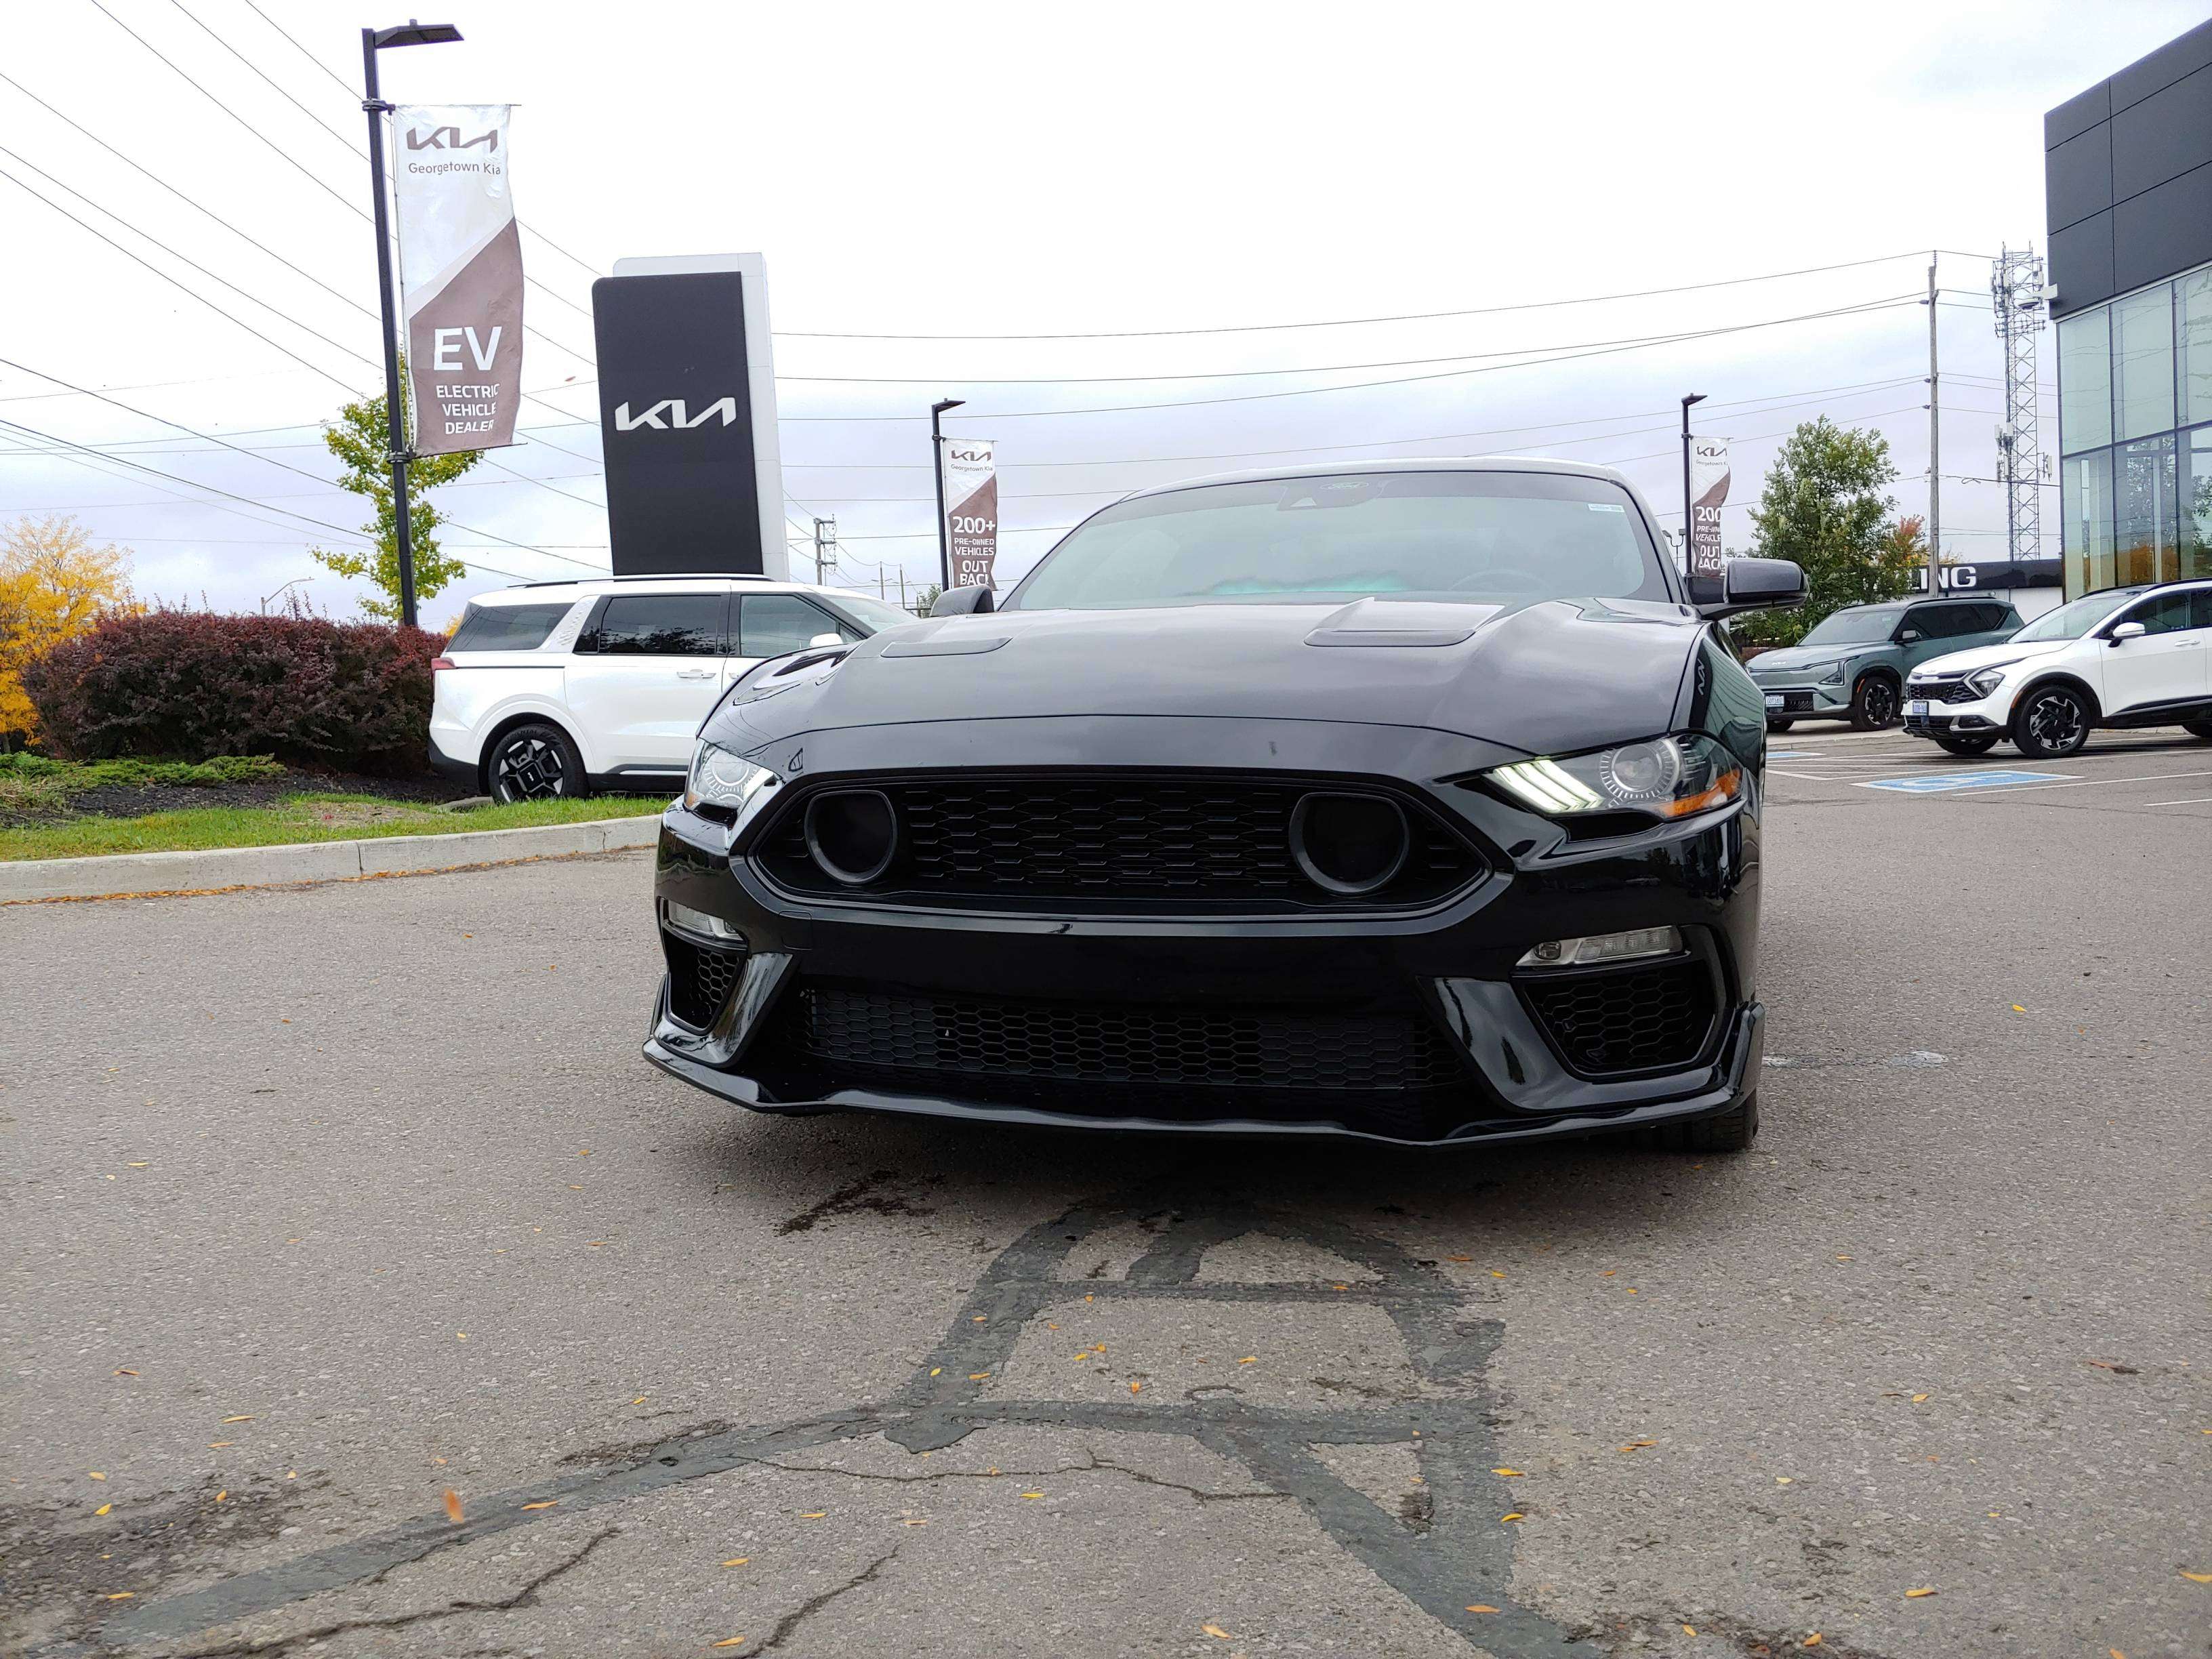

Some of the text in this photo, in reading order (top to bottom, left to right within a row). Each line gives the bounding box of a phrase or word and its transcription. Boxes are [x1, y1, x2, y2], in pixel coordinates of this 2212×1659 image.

[407, 126, 498, 153] KIA
[408, 161, 501, 176] Georgetown Kia
[434, 326, 503, 371] EV
[436, 384, 500, 398] ELECTRIC
[442, 402, 497, 417] VEHICLE
[615, 397, 737, 431] KIA
[445, 419, 495, 434] DEALER
[951, 450, 991, 462] KIA
[1696, 446, 1727, 457] KIA
[951, 464, 983, 472] Georgetown
[952, 516, 996, 534] 200+
[954, 537, 994, 546] PRE-OWNED
[954, 546, 994, 556] VEHICLES
[962, 560, 989, 573] OUT
